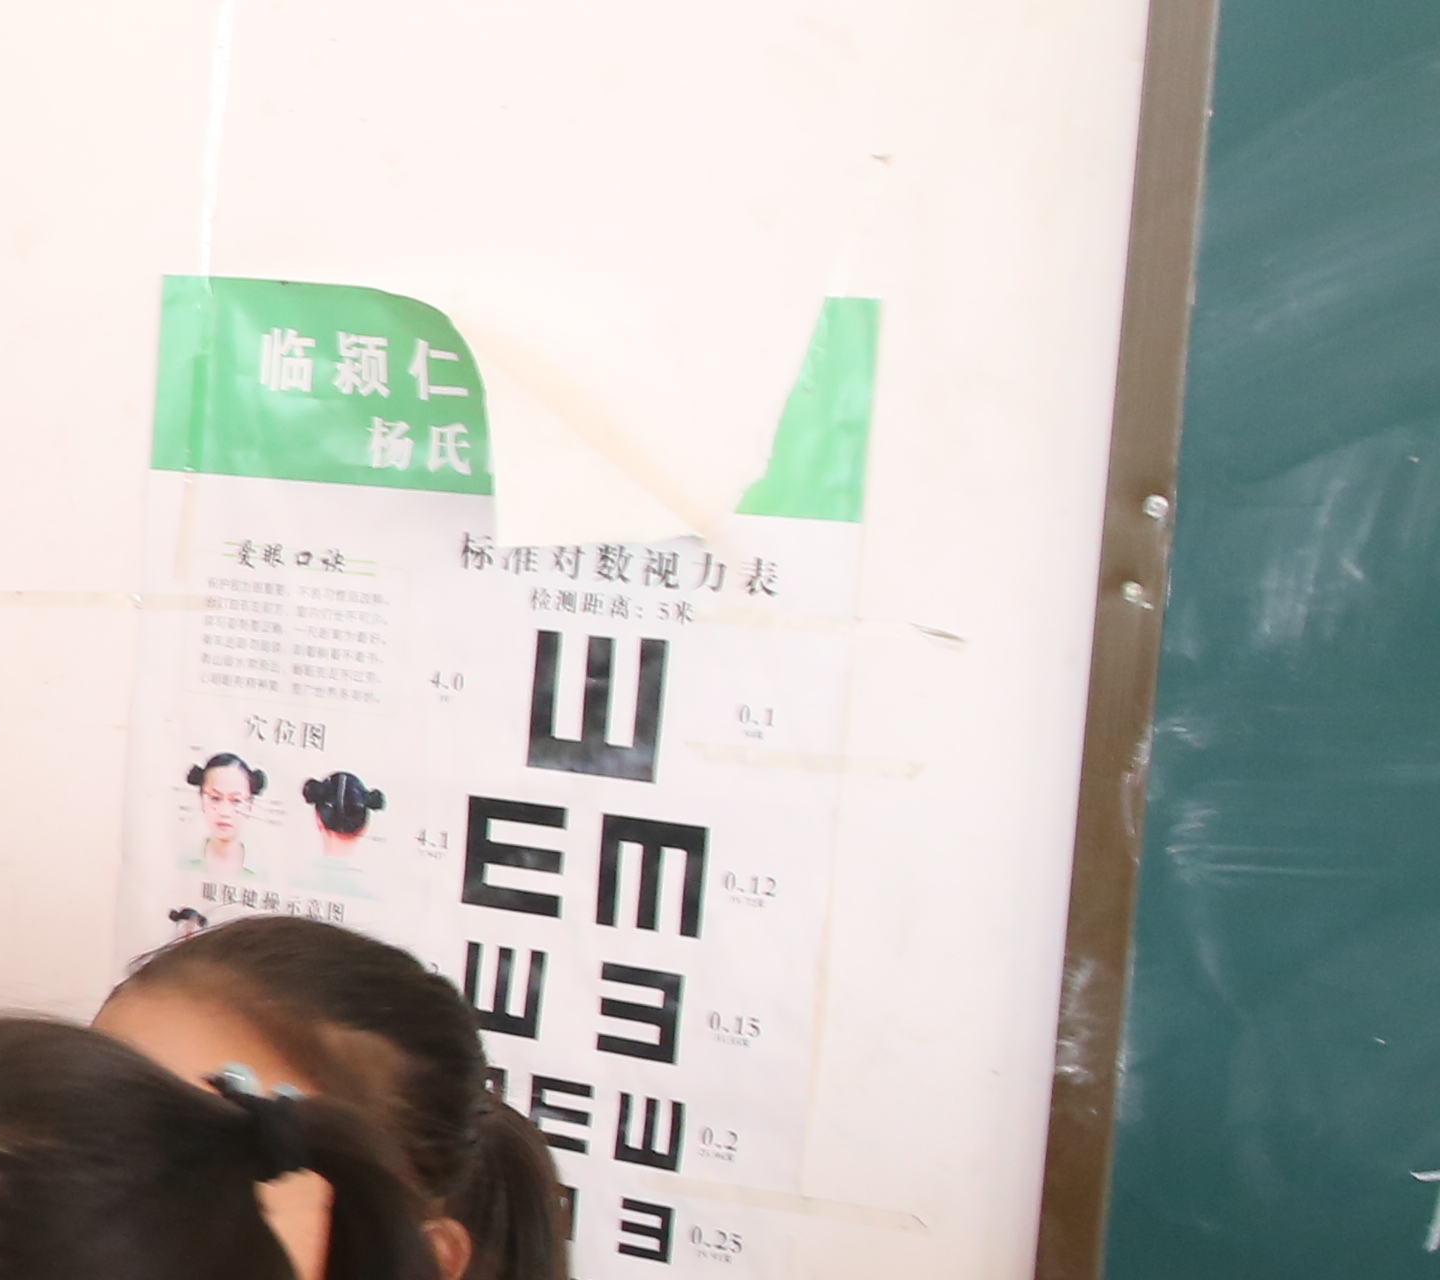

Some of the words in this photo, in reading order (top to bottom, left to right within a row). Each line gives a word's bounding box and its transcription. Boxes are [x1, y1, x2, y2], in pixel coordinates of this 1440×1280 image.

[366, 415, 473, 476] 杨氏
[237, 538, 347, 574] 爱眼口诀
[459, 531, 781, 597] 标准对数视力表
[737, 703, 775, 728] 0.1
[243, 713, 328, 752] 穴位图
[722, 870, 778, 899] 0.12
[707, 1010, 762, 1040] 0.15
[699, 1126, 740, 1154] 0.2
[689, 1225, 744, 1254] 0.25
